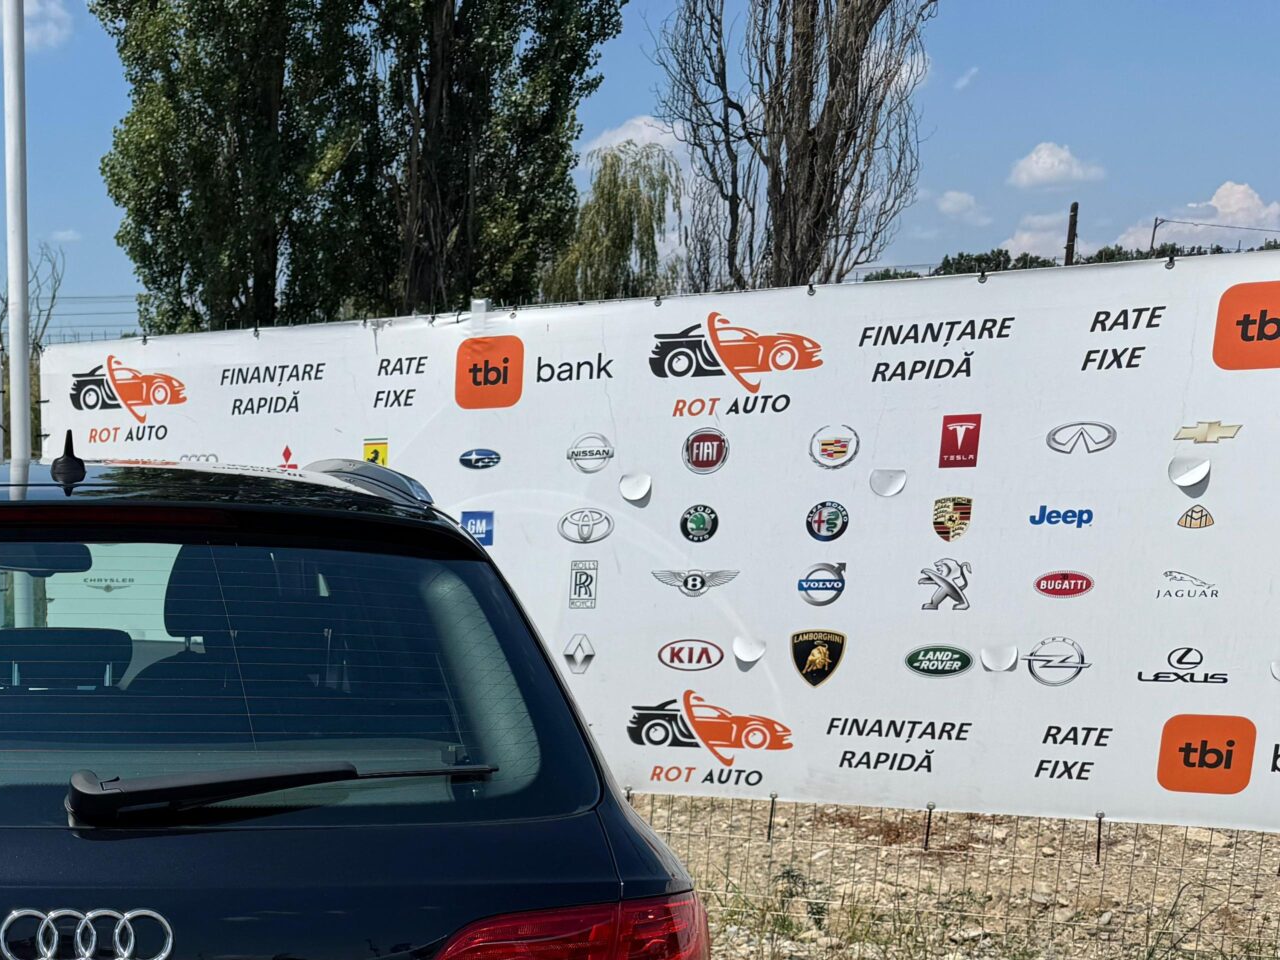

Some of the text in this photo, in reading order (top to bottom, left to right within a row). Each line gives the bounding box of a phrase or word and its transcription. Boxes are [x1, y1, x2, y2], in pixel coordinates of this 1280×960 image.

[1090, 305, 1166, 333] RATE
[858, 316, 1015, 347] FINANȚARE
[377, 356, 428, 376] RATE
[871, 350, 976, 383] RAPIDĂ
[1081, 346, 1146, 371] FIXE
[220, 362, 326, 388] FINANȚARE
[468, 353, 614, 387] tbi bank
[231, 391, 300, 416] RAPIDĂ
[373, 389, 416, 409] FIXE
[672, 394, 791, 417] ROT AUTO
[88, 425, 168, 443] ROT AUTO
[570, 448, 610, 458] NISSAN
[692, 442, 718, 461] FIAT
[825, 501, 848, 522] ROMEO
[1029, 505, 1093, 528] Jeep
[467, 519, 486, 534] GM
[801, 581, 842, 590] VOLVO
[1039, 579, 1087, 592] BUGATTI
[1156, 589, 1219, 599] JAGUAR
[793, 631, 844, 645] LAMBORGHINI
[669, 646, 712, 664] KIA
[918, 650, 953, 662] LAND
[920, 659, 962, 672] ROVER
[1137, 671, 1229, 684] LEXUS
[826, 716, 972, 745] FINANȚARE
[1042, 725, 1113, 748] RATE
[839, 750, 933, 774] RAPIDĂ
[1178, 739, 1235, 770] tbi
[650, 766, 763, 787] ROT AUTO
[1034, 760, 1094, 781] FIXE
